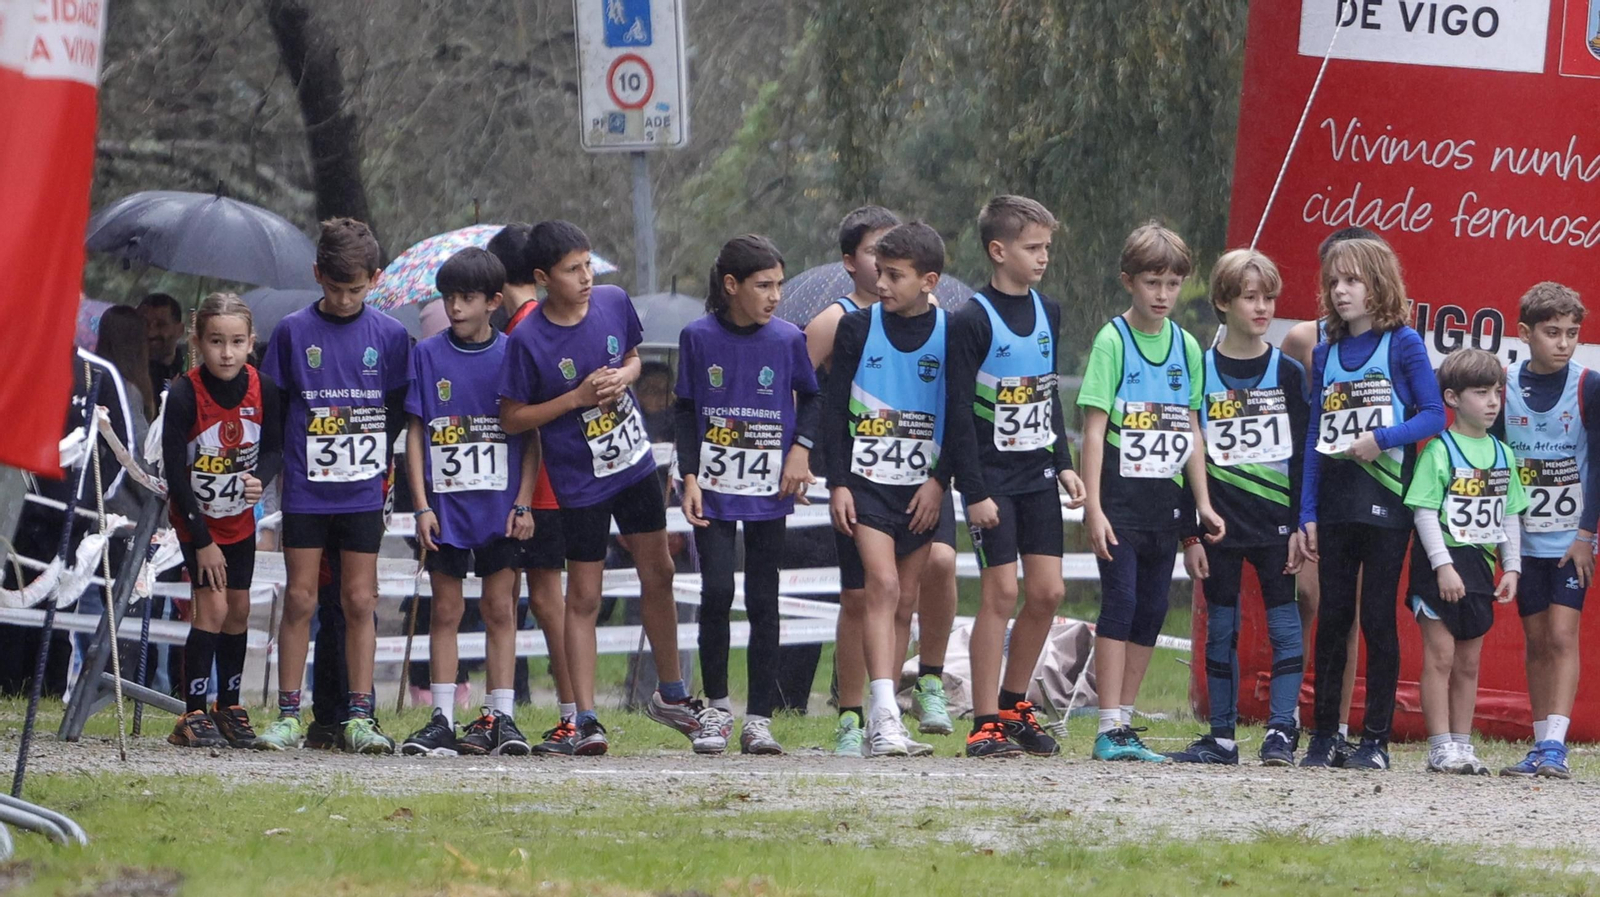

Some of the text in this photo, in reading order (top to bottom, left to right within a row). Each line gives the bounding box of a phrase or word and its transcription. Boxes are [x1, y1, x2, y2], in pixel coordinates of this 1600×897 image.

[1336, 0, 1499, 38] DE VIGO
[619, 73, 641, 92] 10
[1320, 117, 1476, 170] Vivimos
[1302, 182, 1433, 232] cidade
[1407, 299, 1518, 364] IGO,
[319, 389, 349, 399] CHANS
[350, 388, 382, 399] BEMBRIV
[1249, 388, 1284, 397] MEMORIAL
[1259, 403, 1286, 411] ALONSO
[1351, 388, 1391, 397] BELARMINO
[1363, 395, 1391, 403] ALONSO
[350, 415, 386, 423] BELARMINO
[360, 422, 385, 430] ALONSO
[741, 407, 782, 419] BEMBRIVE
[898, 420, 934, 429] BELARMINO
[997, 401, 1051, 435] 348
[1322, 408, 1387, 443] 344
[597, 414, 641, 462] 313
[908, 428, 932, 436] ALONSO
[1215, 416, 1280, 450] 351
[315, 435, 377, 467] 312
[441, 445, 495, 477] 311
[856, 438, 927, 470] 346
[1124, 432, 1188, 463] 349
[705, 446, 771, 480] 314
[1520, 467, 1537, 485] 6º
[1542, 464, 1578, 476] BELARMINO
[194, 474, 246, 502] 34
[1553, 473, 1579, 483] ALONSO
[1450, 497, 1504, 528] 350
[1520, 487, 1577, 517] 26
